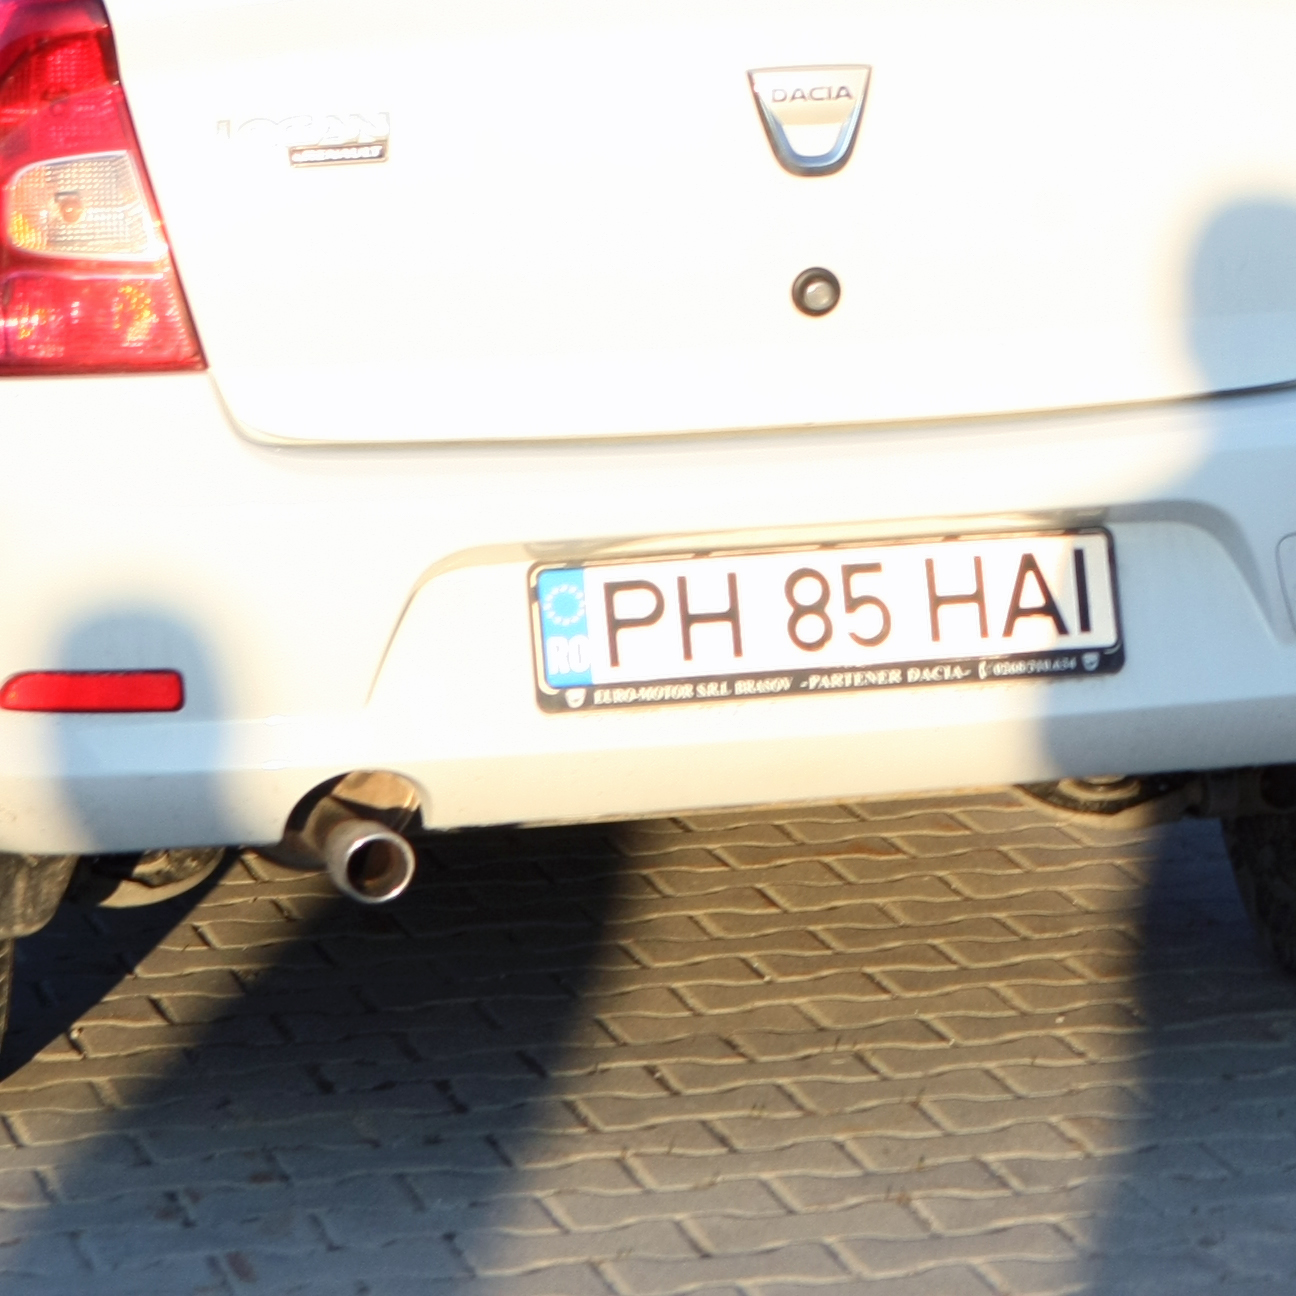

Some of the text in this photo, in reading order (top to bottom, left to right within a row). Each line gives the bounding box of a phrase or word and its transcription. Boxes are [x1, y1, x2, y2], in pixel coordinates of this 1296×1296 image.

[771, 85, 854, 103] DACIA
[602, 548, 1093, 667] PH 85 HAI
[546, 635, 591, 675] RO
